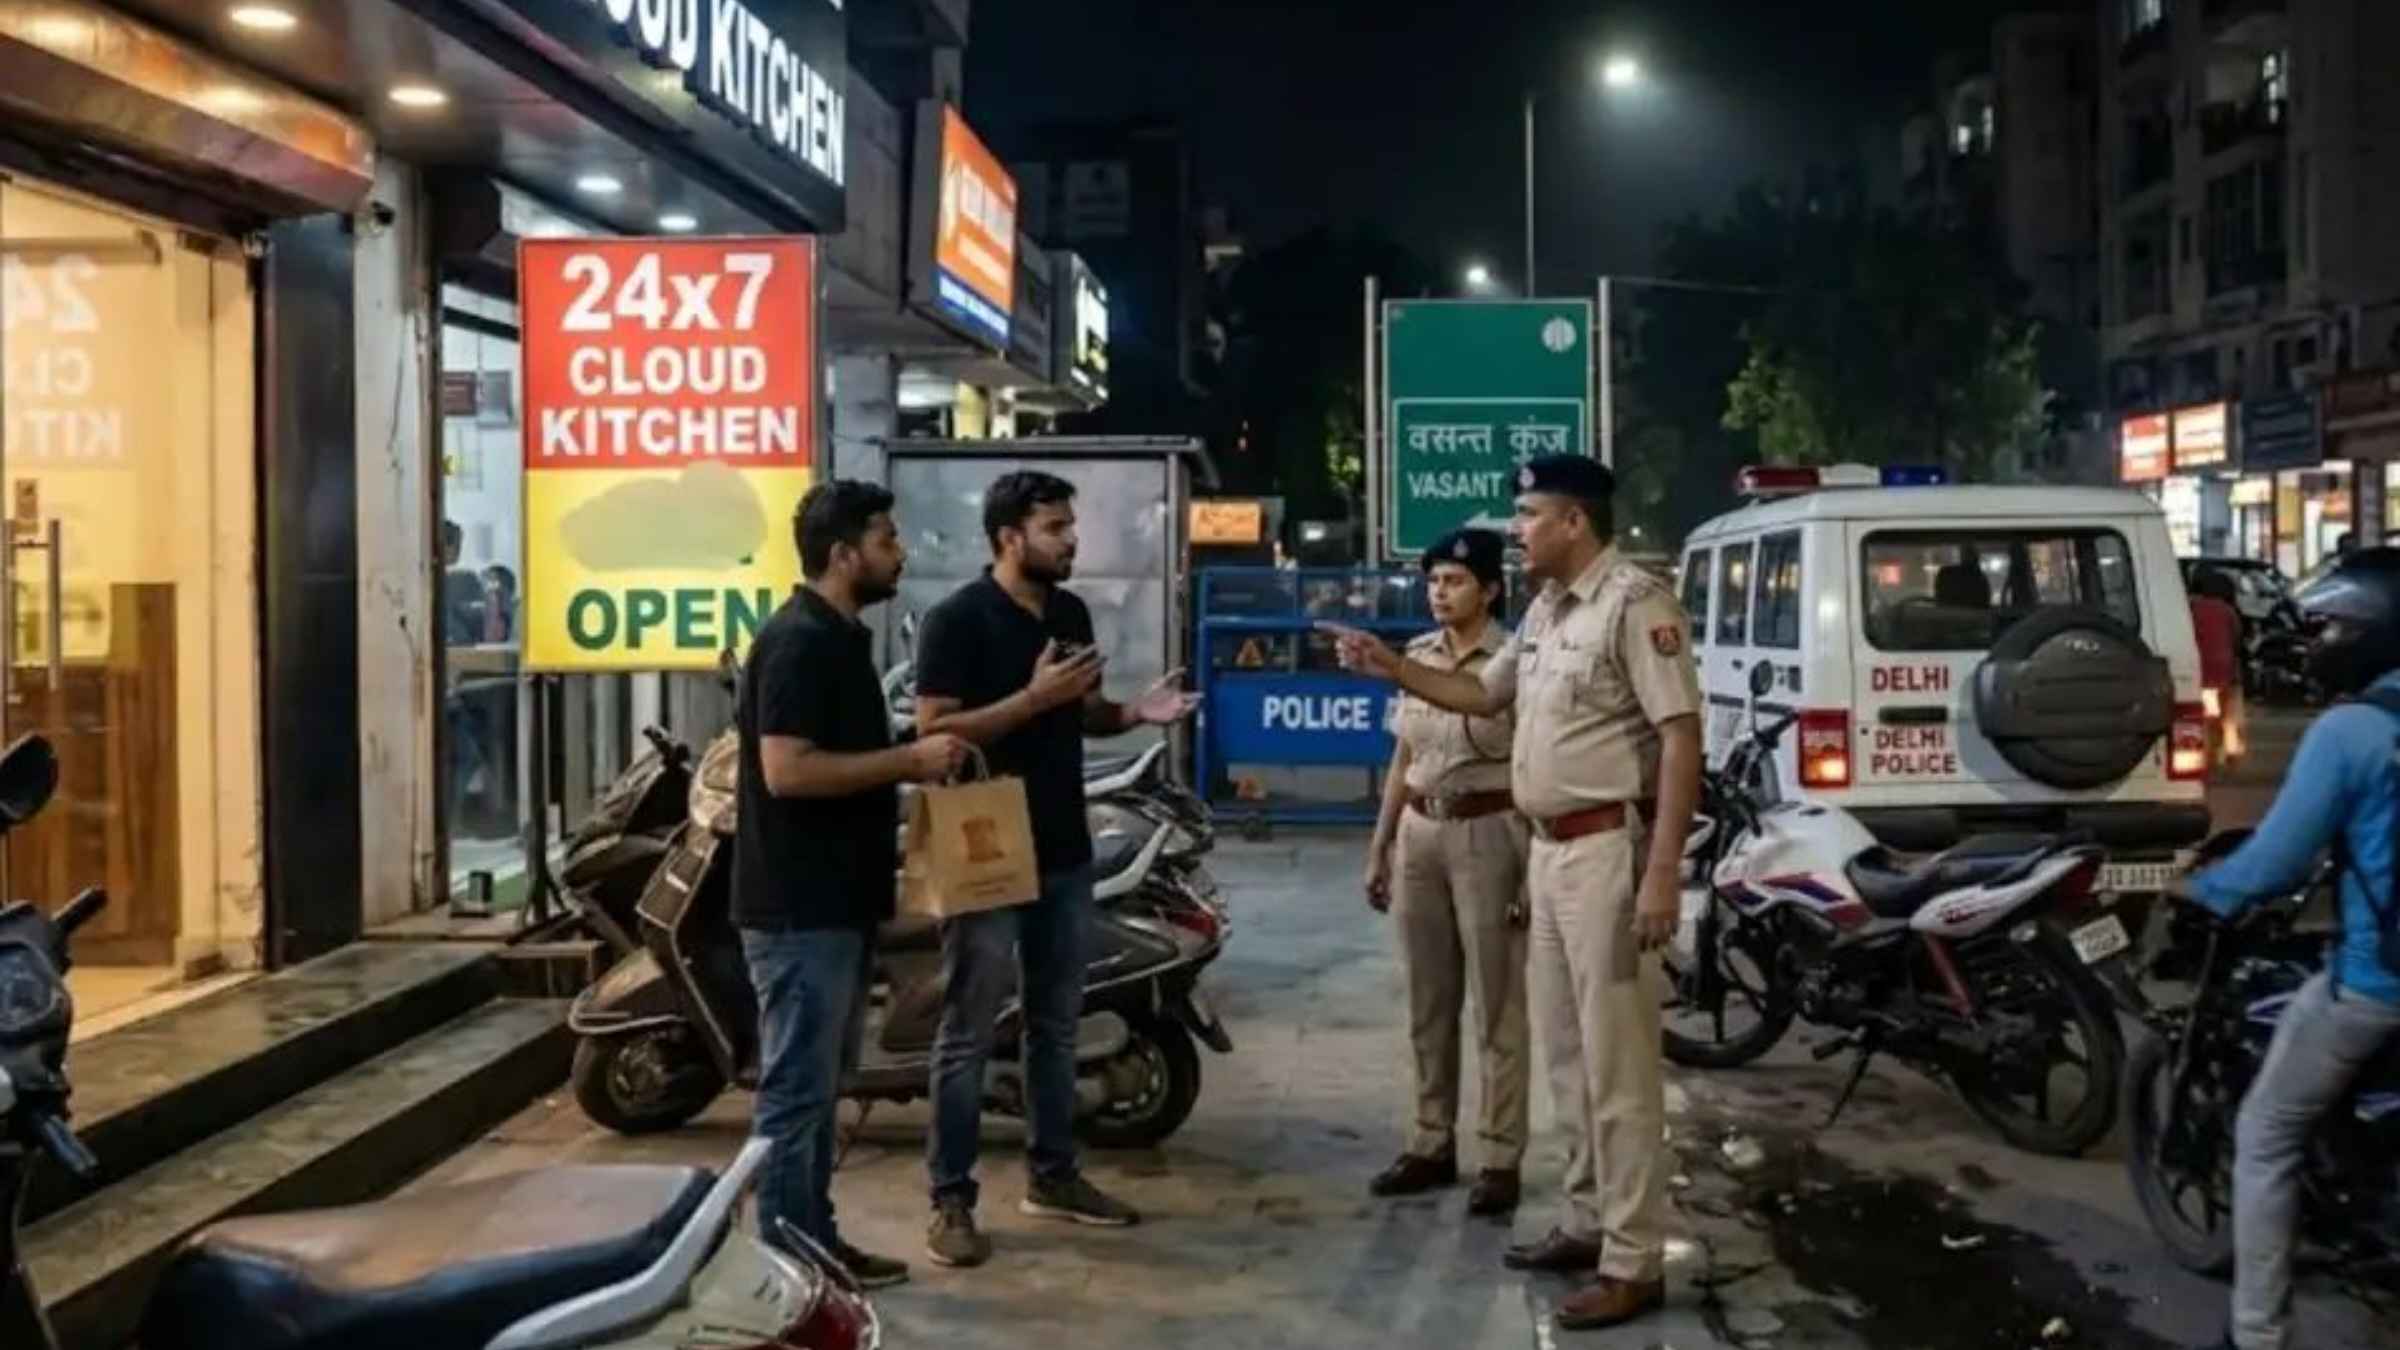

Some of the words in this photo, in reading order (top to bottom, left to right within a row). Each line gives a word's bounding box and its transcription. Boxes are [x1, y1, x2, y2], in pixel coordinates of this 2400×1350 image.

[710, 0, 844, 187] KITCHEN
[561, 252, 774, 331] 24x7
[568, 345, 768, 396] CLOUD
[540, 406, 798, 457] KITCHEN
[1406, 471, 1504, 499] VASANT
[567, 588, 772, 650] OPEN
[1871, 666, 1949, 692] DELHI
[1262, 696, 1371, 730] POLICE
[1871, 753, 1956, 774] POLICE
